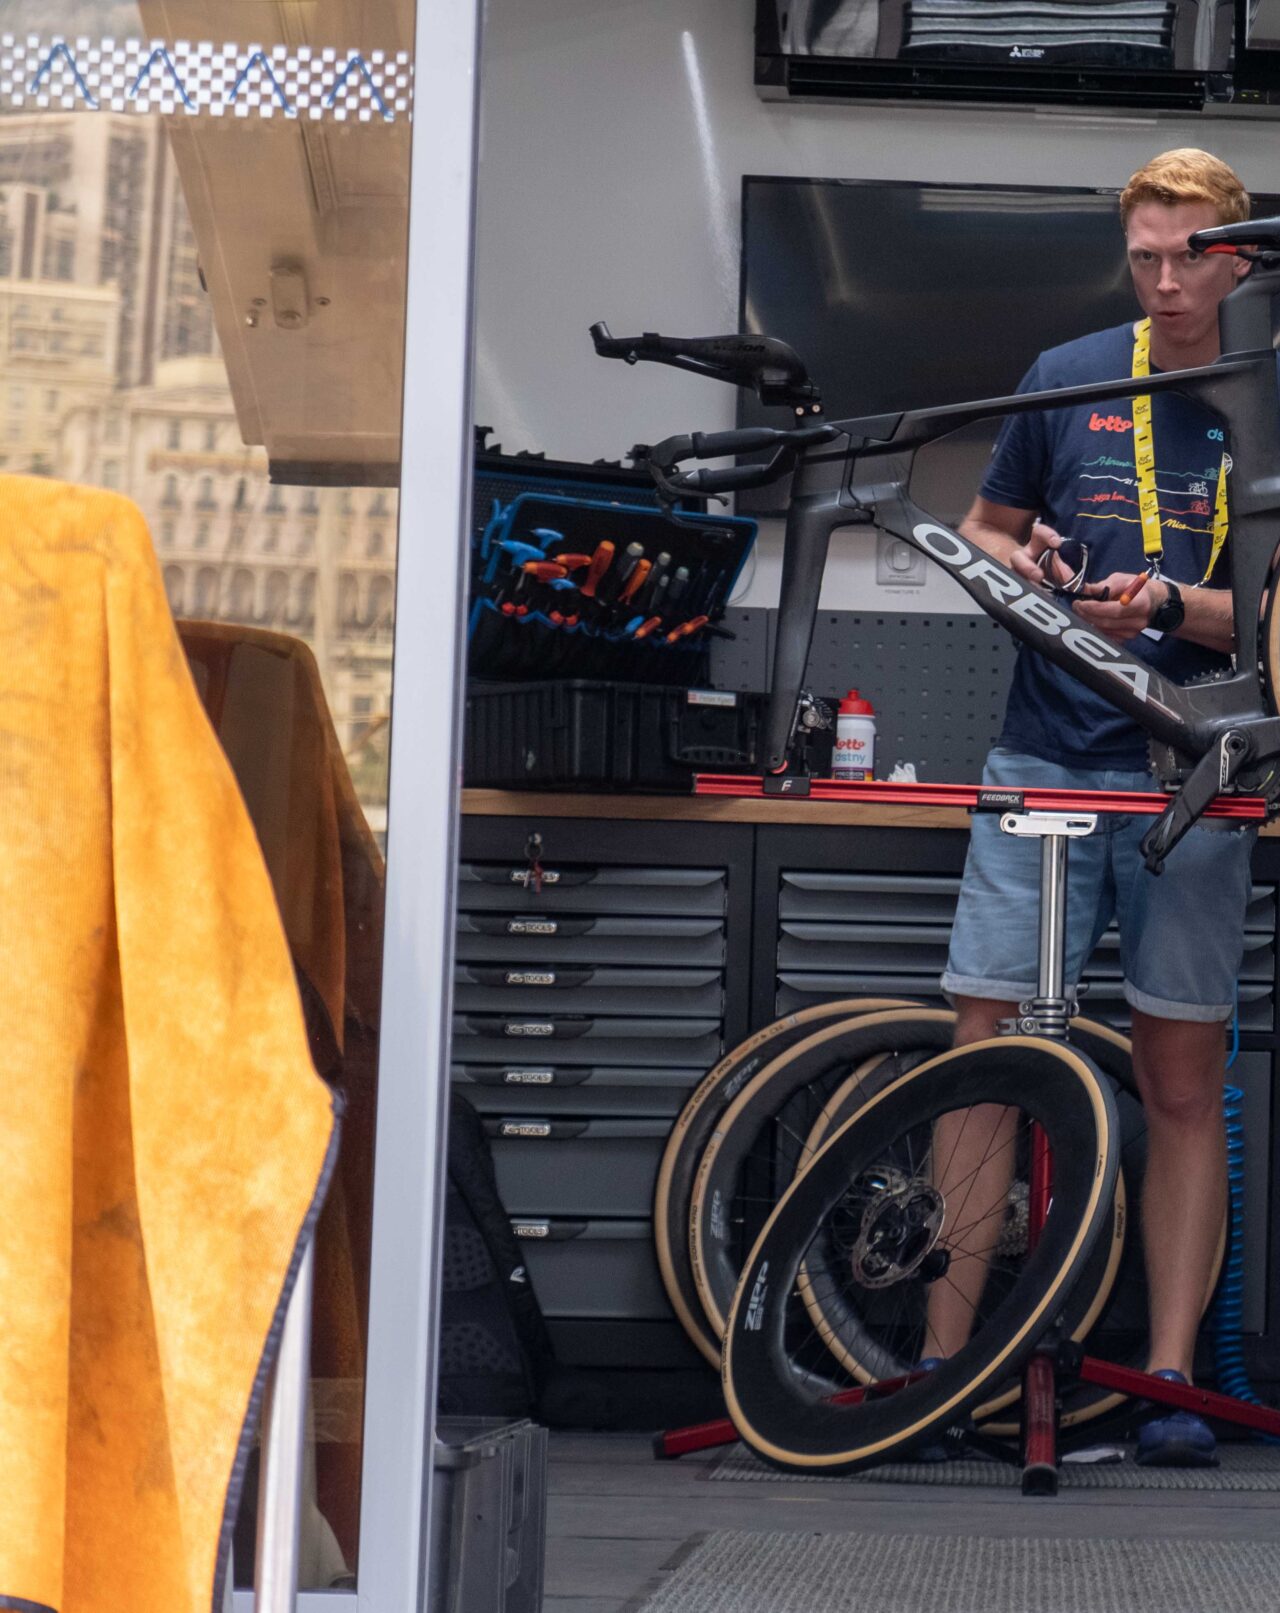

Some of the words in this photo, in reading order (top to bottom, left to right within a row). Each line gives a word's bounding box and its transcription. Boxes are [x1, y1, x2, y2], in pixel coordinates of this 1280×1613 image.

[1089, 413, 1133, 433] lotto
[913, 523, 1149, 703] ORBEA
[835, 738, 865, 750] lotto
[834, 751, 866, 764] dstny
[982, 793, 1020, 802] FEEDBACK
[744, 1261, 768, 1331] ZIPP
